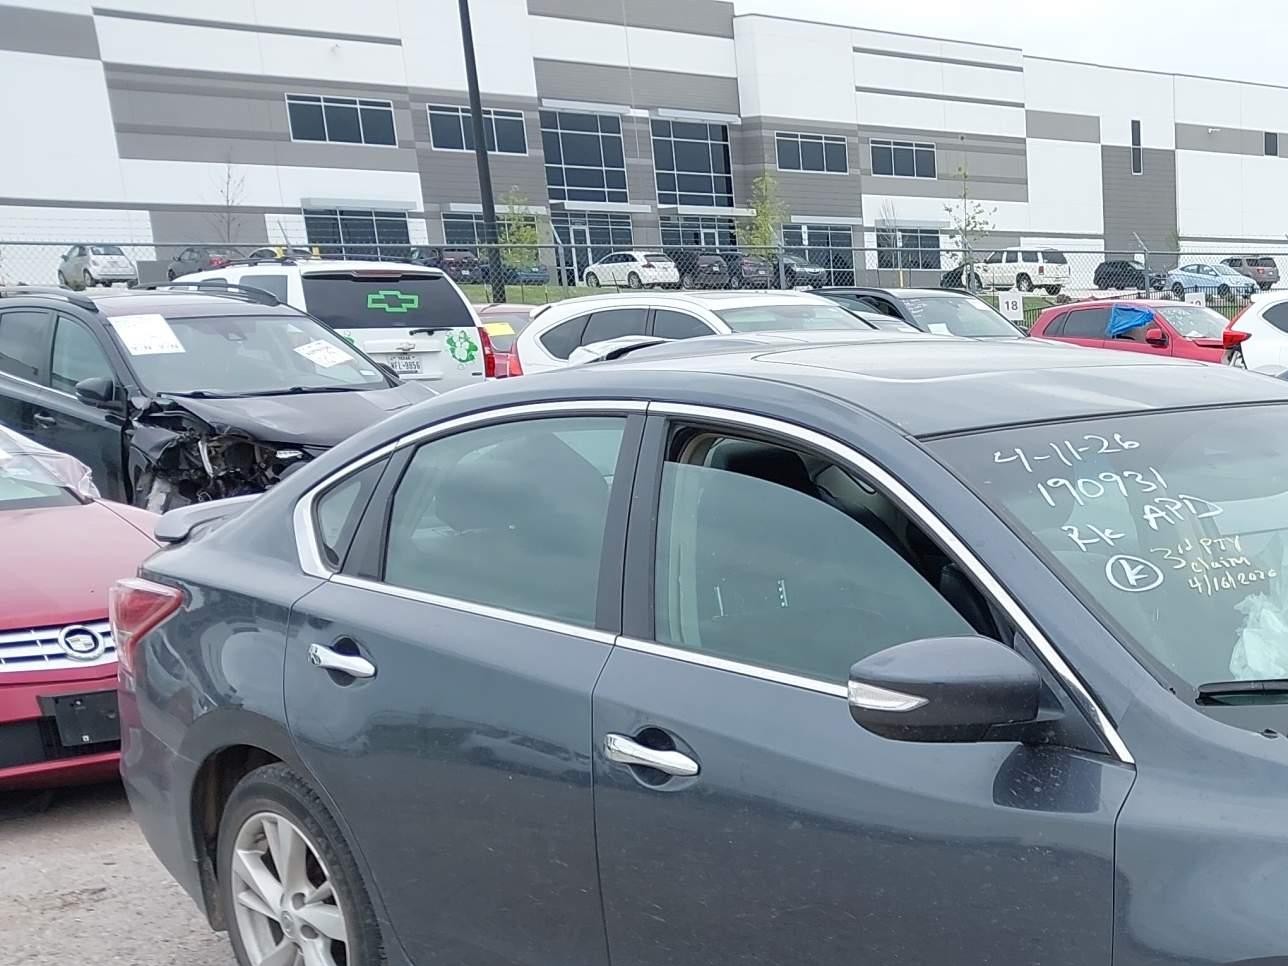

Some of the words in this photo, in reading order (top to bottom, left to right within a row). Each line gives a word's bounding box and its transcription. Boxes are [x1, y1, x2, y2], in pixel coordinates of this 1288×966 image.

[1004, 300, 1018, 311] 18
[993, 433, 1140, 473] 4-11-26
[1036, 466, 1168, 507] 190931
[1143, 494, 1224, 530] APD
